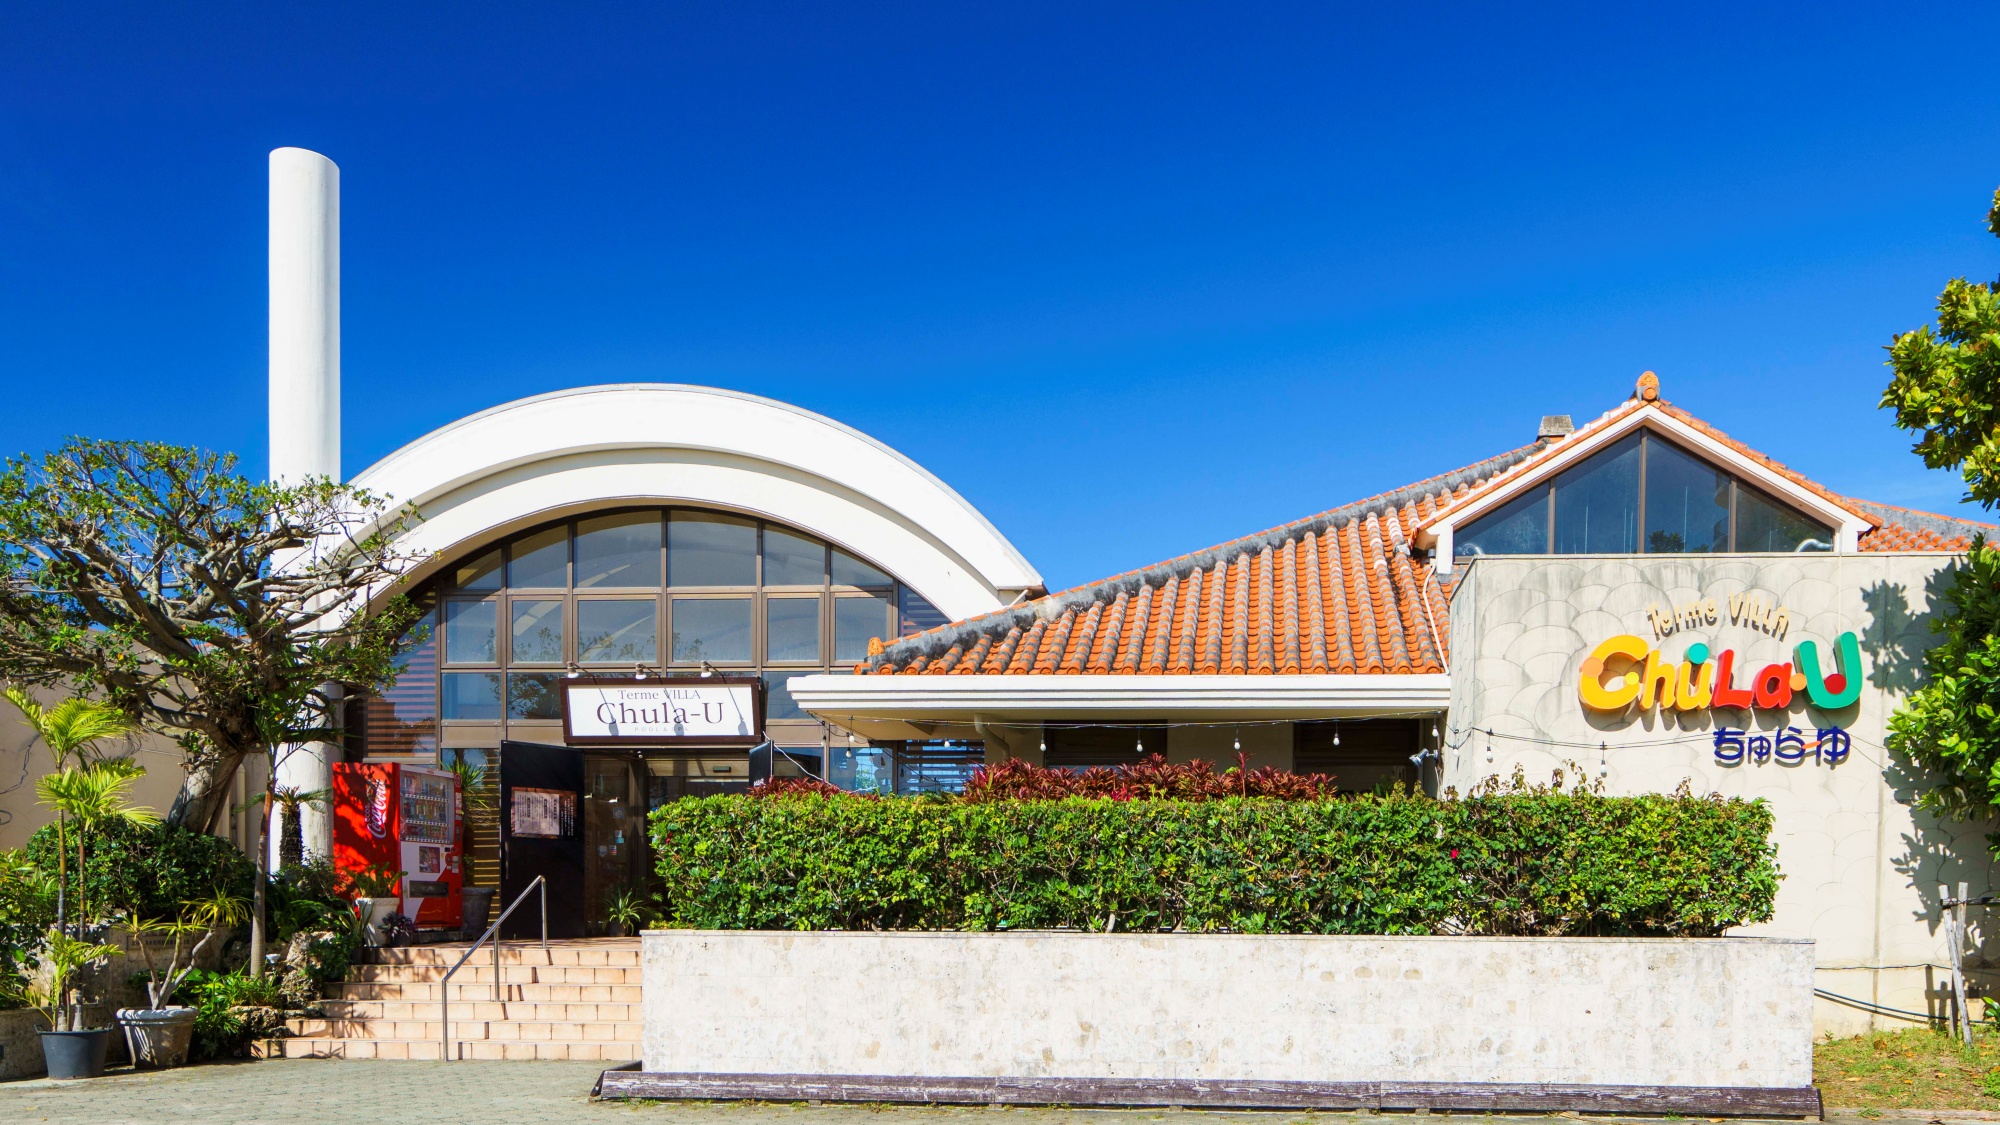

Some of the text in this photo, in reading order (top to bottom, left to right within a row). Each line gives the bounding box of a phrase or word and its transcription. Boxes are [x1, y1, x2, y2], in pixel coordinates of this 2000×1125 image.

[1646, 597, 1717, 632] Terme
[618, 689, 701, 700] Terme VILLA
[596, 701, 724, 724] Chula-U
